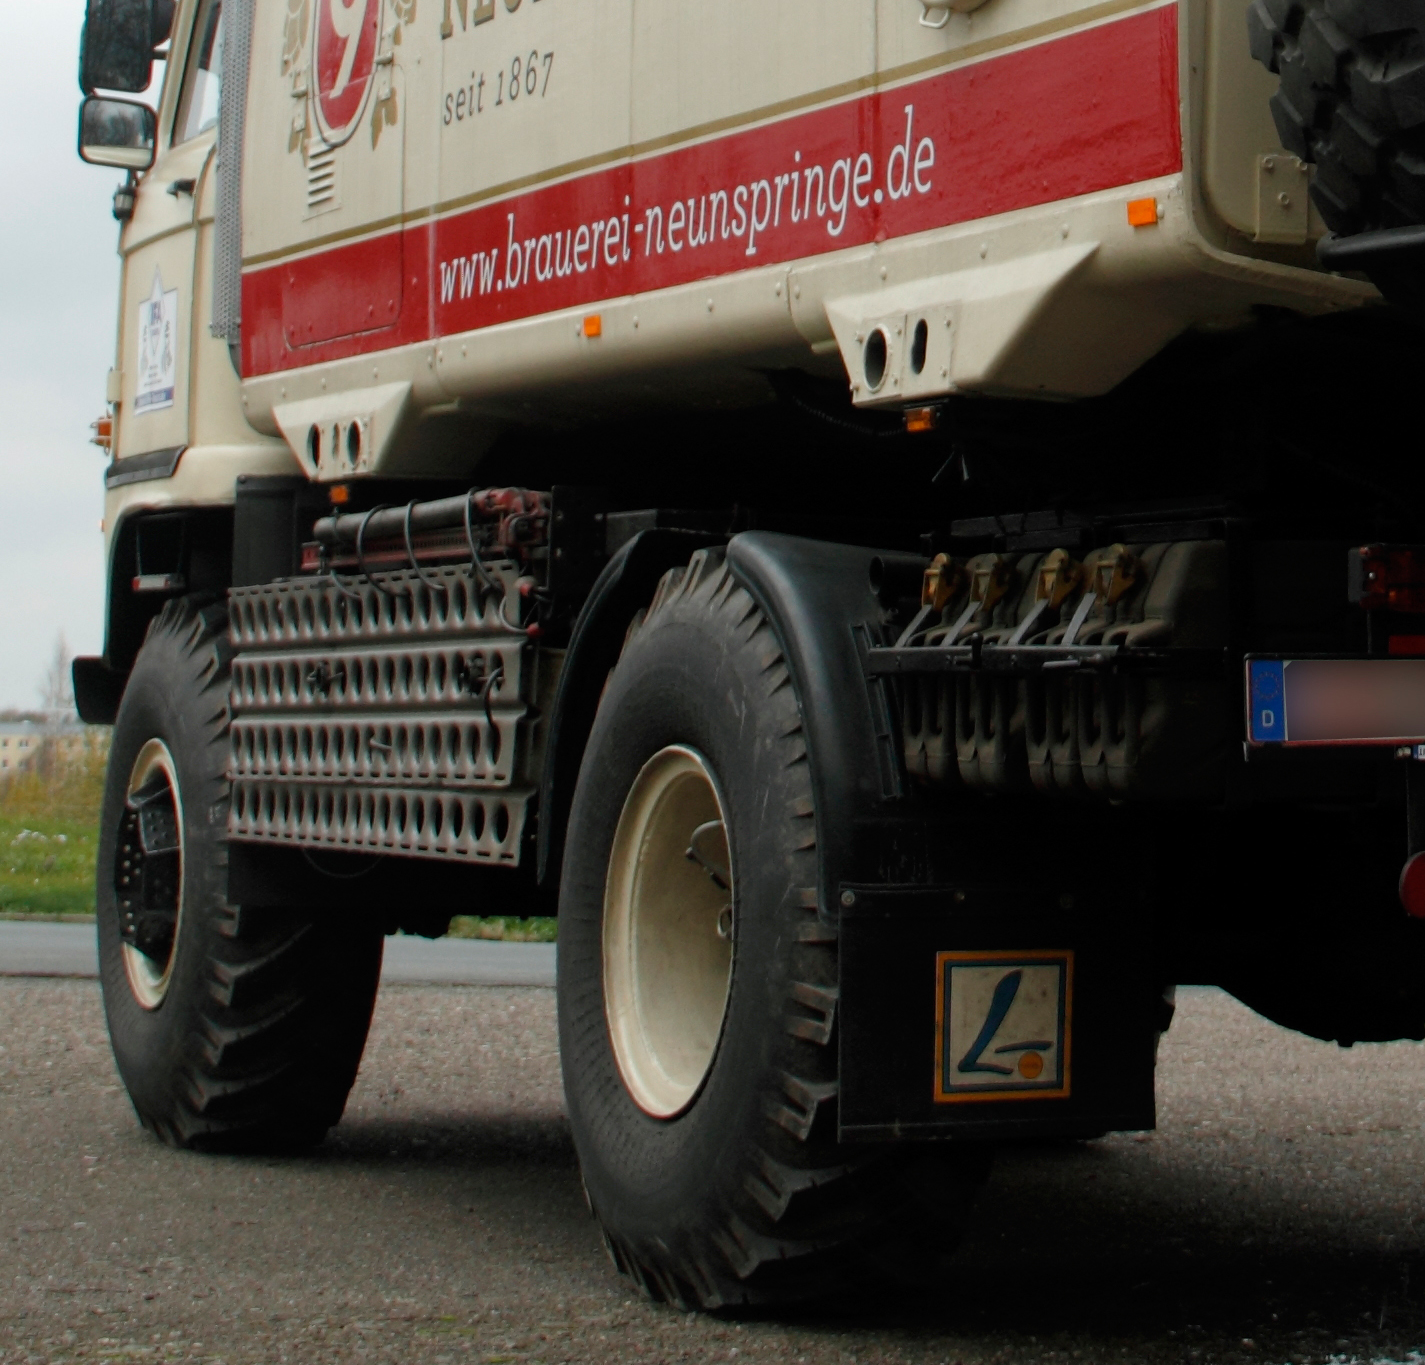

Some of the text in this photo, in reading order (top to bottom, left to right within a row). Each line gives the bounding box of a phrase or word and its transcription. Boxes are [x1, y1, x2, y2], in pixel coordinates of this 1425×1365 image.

[443, 49, 554, 125] seit 1867
[440, 104, 935, 304] www.brauerei-neunspringe.de
[1262, 709, 1275, 727] D
